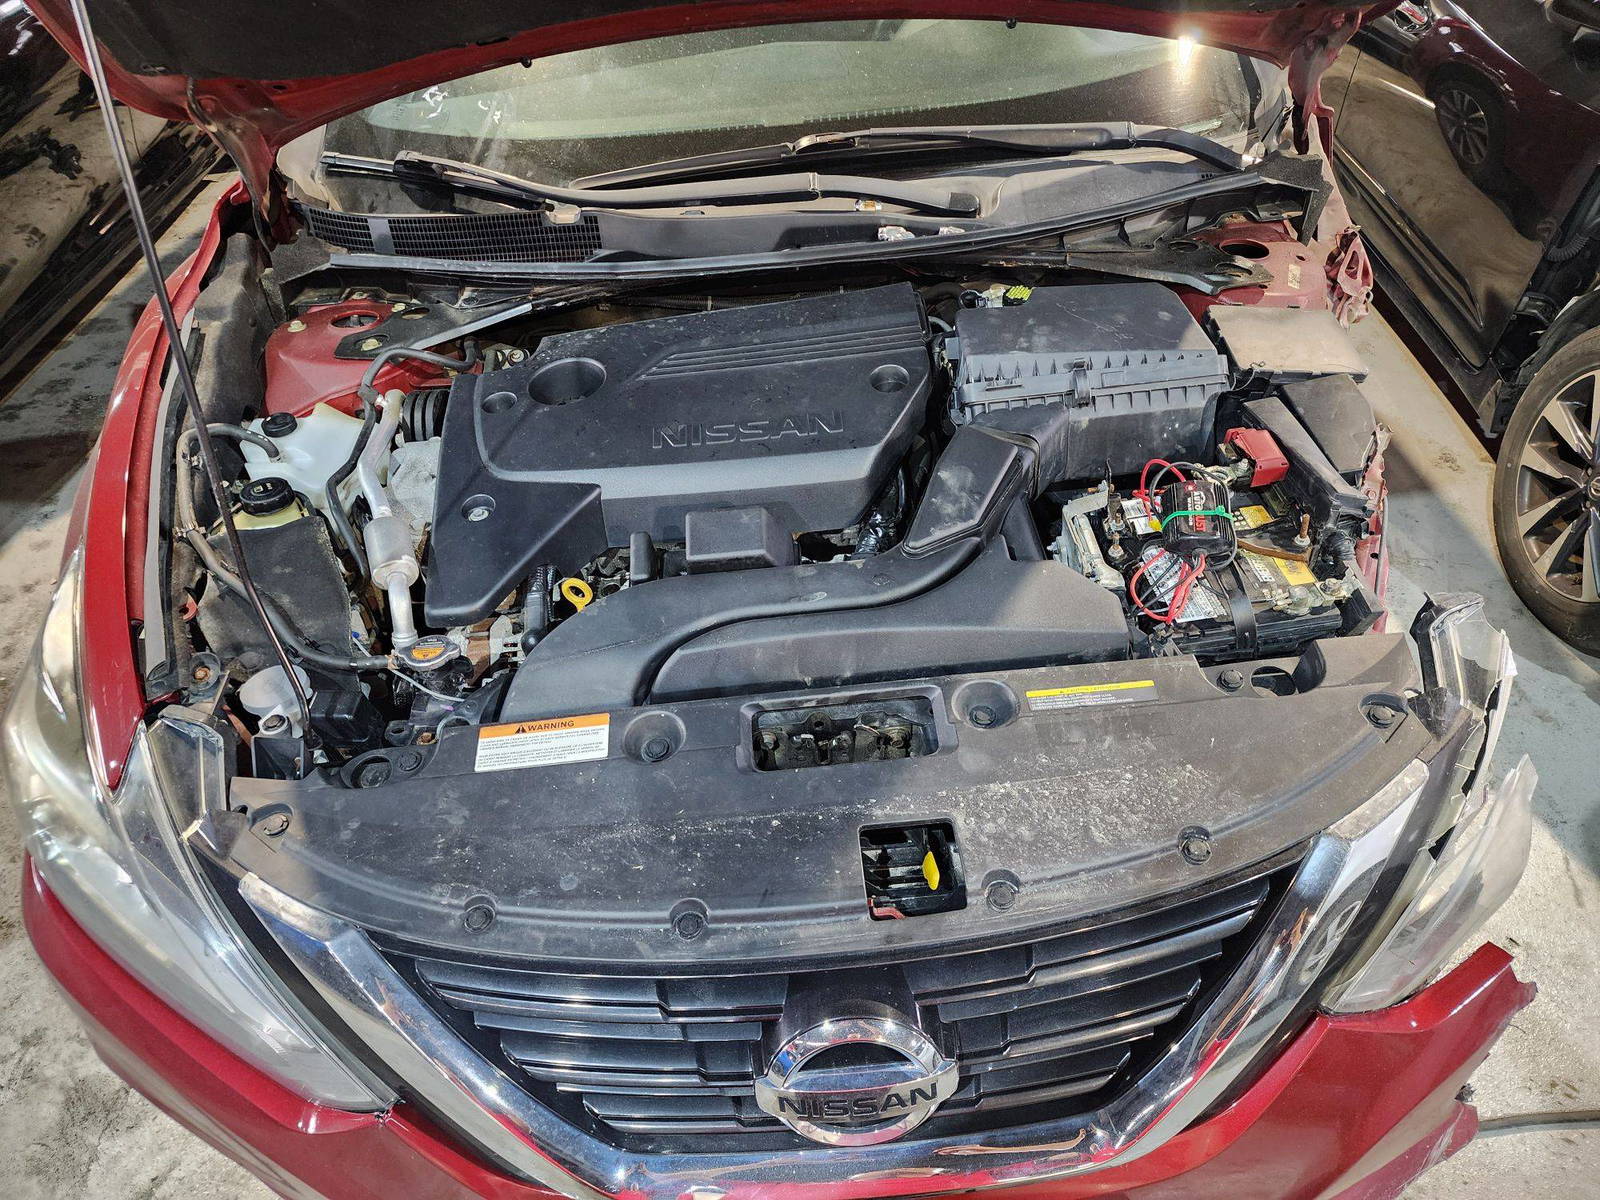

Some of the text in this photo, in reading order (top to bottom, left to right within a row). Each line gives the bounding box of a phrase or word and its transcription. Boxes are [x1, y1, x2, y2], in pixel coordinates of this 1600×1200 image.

[652, 408, 843, 449] NISSAN
[528, 720, 575, 732] WARNING
[778, 1082, 938, 1118] NISSAN
